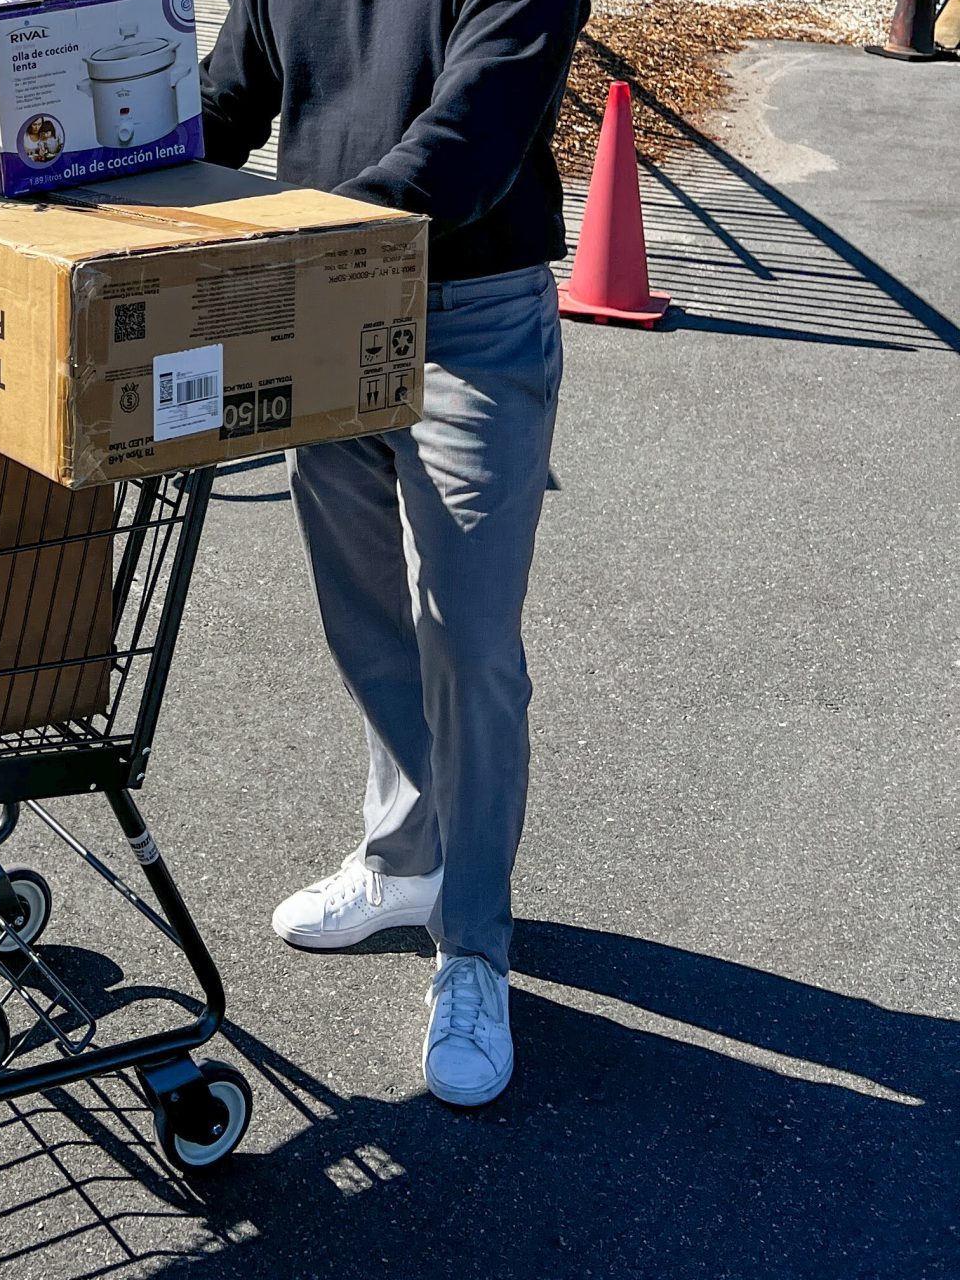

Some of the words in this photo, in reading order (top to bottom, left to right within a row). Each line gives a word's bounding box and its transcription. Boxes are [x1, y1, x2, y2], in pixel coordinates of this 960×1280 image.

[10, 29, 49, 44] RIVAL
[12, 51, 30, 62] olla
[31, 49, 43, 59] de
[45, 43, 79, 57] cocción
[13, 62, 37, 73] lenta
[64, 163, 86, 180] olla
[89, 159, 105, 173] de
[107, 152, 153, 171] cocción
[155, 144, 186, 161] lenta
[223, 401, 253, 429] 50
[263, 395, 287, 422] 01
[109, 440, 127, 451] Tube
[128, 437, 144, 448] LED
[125, 447, 143, 459] Type
